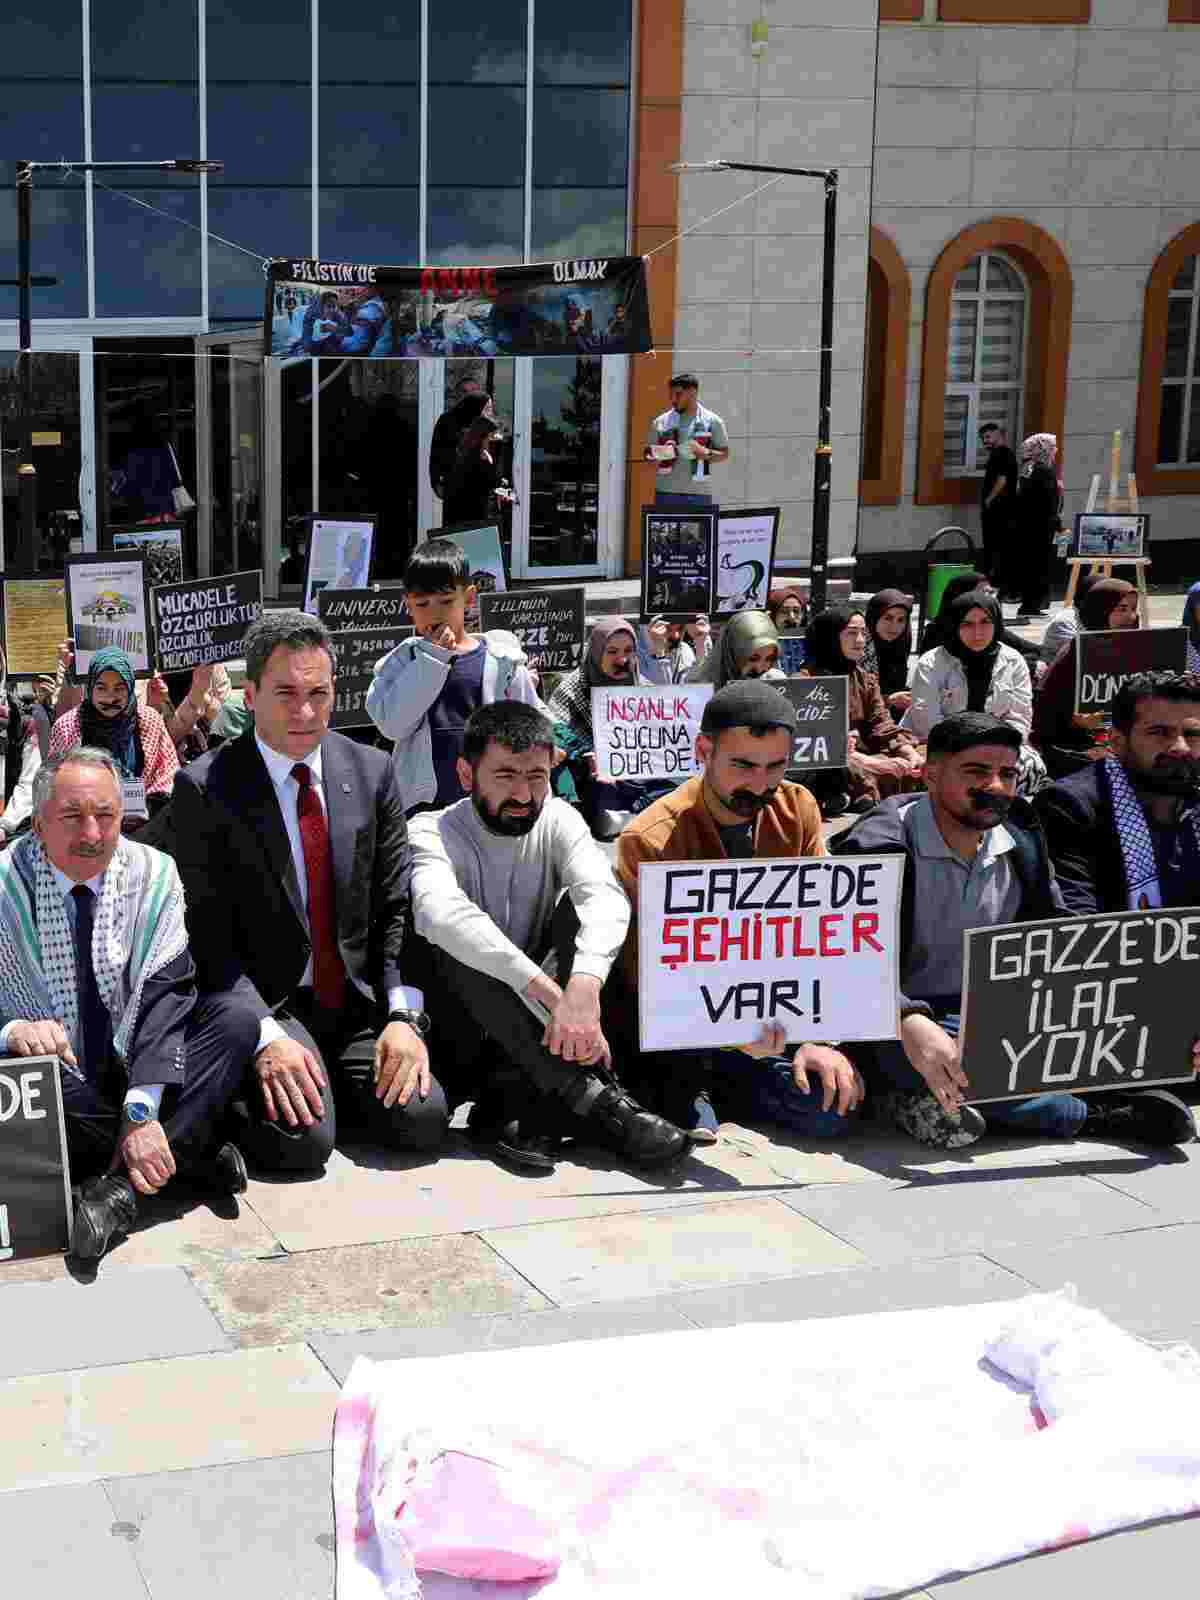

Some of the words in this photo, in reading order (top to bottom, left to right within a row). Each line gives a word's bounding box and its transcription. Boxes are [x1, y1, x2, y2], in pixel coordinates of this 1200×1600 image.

[553, 260, 608, 283] OLMAK
[609, 750, 653, 776] DUR
[664, 863, 883, 914] GAZZE'DE
[660, 912, 885, 970] ŞEHİTLER
[990, 916, 1200, 981] GAZZE'DE
[1001, 1026, 1149, 1091] YOK!
